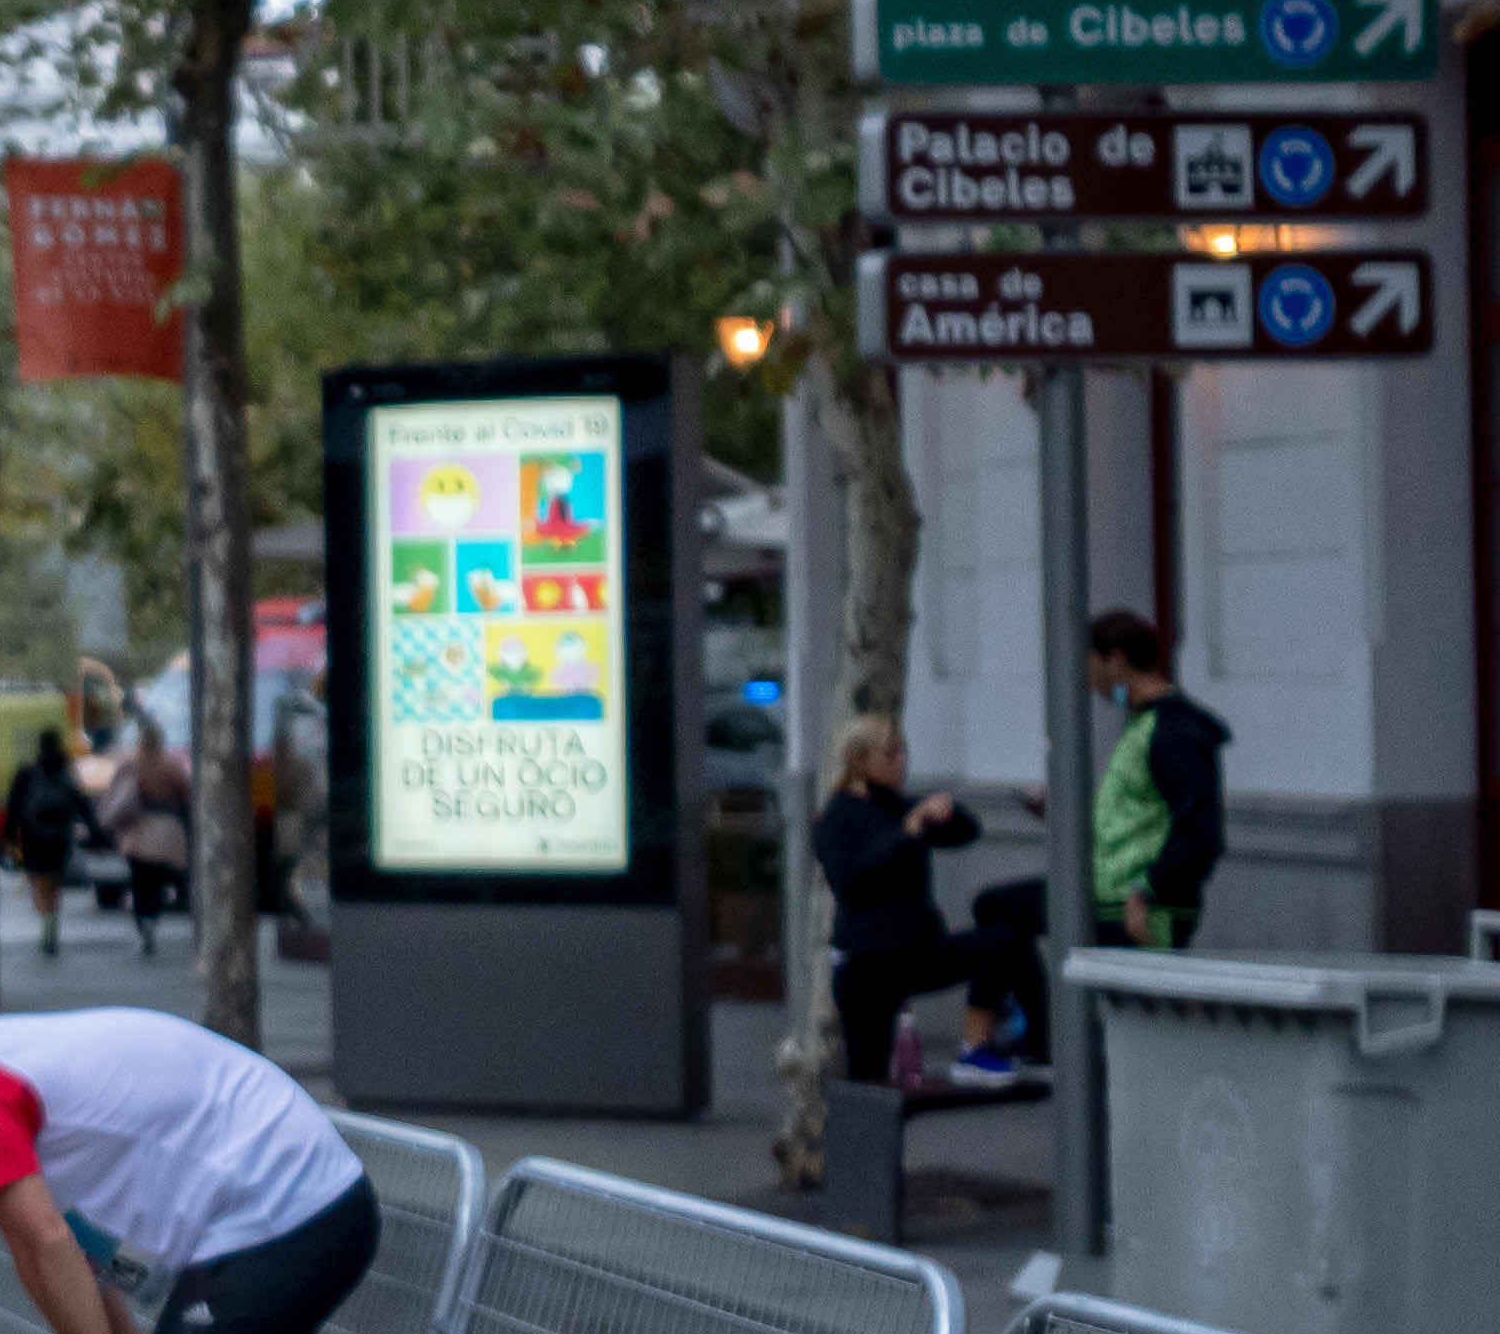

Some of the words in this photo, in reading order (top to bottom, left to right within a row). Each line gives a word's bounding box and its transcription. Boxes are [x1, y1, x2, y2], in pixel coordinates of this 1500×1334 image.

[893, 17, 984, 50] plaza
[1006, 16, 1048, 46] de
[1069, 5, 1246, 47] Cibeles
[899, 122, 1071, 165] Palacio
[1097, 123, 1155, 166] de
[900, 166, 1075, 210] Cibeles
[900, 272, 980, 300] casa
[998, 267, 1044, 300] de
[901, 299, 1095, 347] América
[422, 728, 587, 757] DISFRUTA
[403, 760, 438, 789] DE
[458, 761, 506, 788] UN
[518, 758, 608, 789] OCIO
[433, 788, 577, 819] SEGURO
